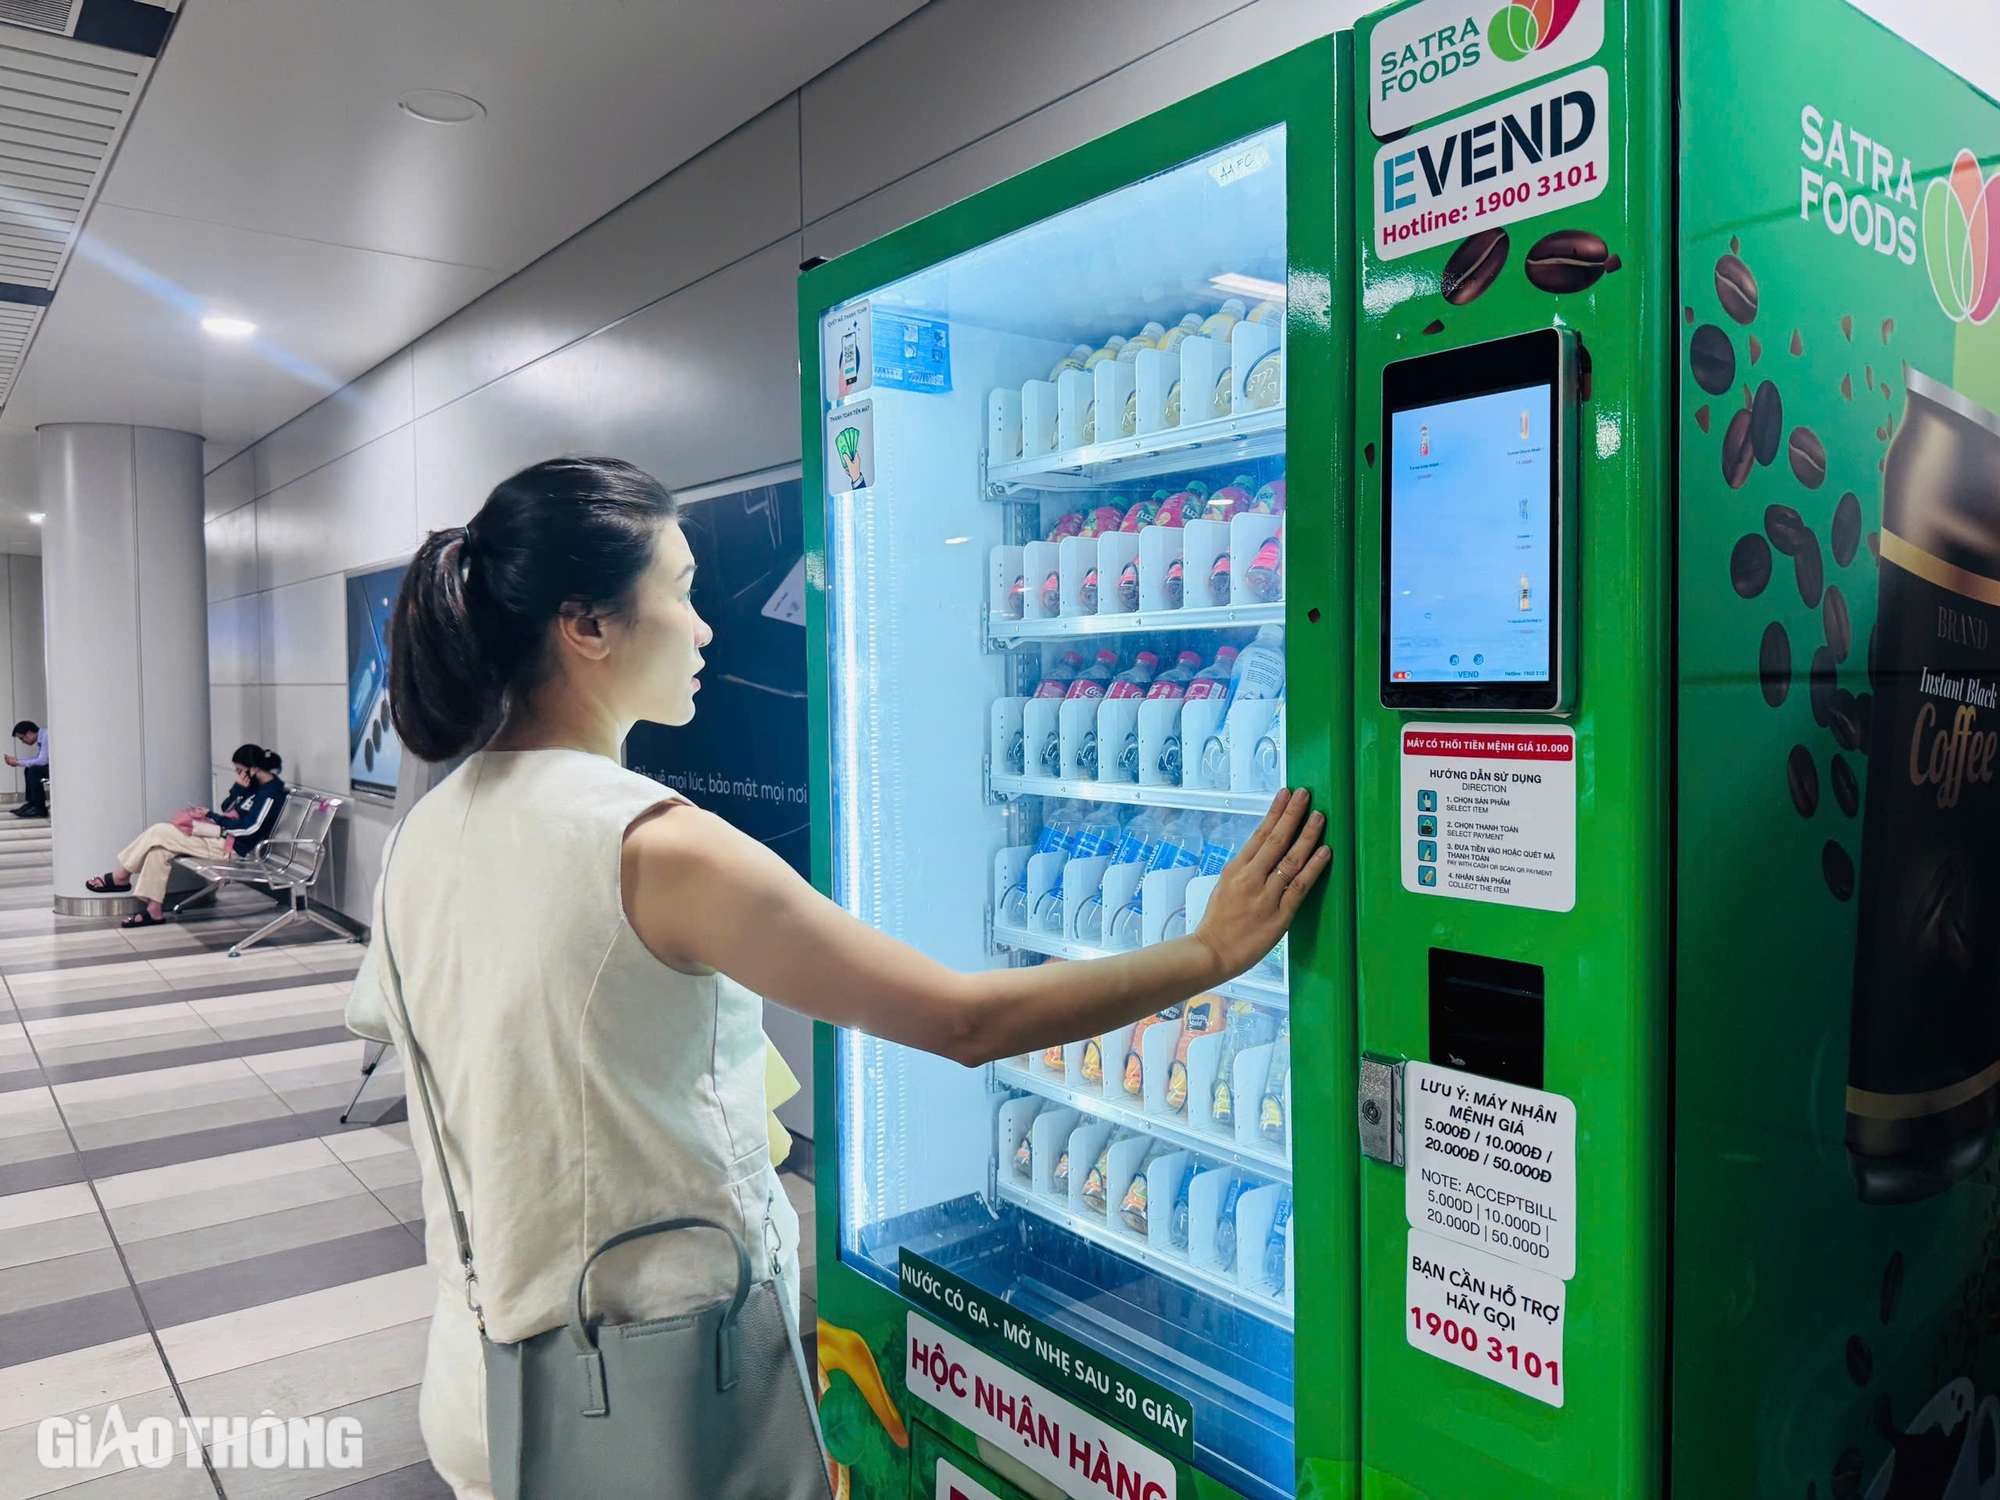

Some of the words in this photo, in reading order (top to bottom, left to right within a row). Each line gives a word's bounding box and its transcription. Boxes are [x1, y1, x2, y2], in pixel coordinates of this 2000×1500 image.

[1380, 17, 1480, 75] SATRA
[1381, 42, 1480, 101] FOODS
[1384, 90, 1595, 213] EVEND
[1801, 105, 1918, 211] SATRA
[1383, 205, 1468, 245] Hotline:
[1475, 182, 1531, 216] 1900
[1537, 161, 1597, 197] 3101
[1800, 166, 1917, 266] FOODS
[1937, 606, 1989, 649] BRAND
[1920, 666, 1963, 701] Instant
[1965, 678, 1998, 709] Black
[1406, 738, 1424, 748] MÁY
[1425, 738, 1438, 748] CÓ
[1439, 738, 1462, 749] THỐI
[1463, 738, 1485, 750] TIỀN
[1487, 740, 1514, 753] MỆNH
[1517, 741, 1534, 752] GIÁ
[1535, 743, 1569, 753] 10.000
[1910, 702, 1998, 809] Coffee
[668, 771, 687, 793] mọi
[689, 771, 707, 794] lúc,
[708, 773, 731, 794] bảo
[733, 777, 758, 801] mật
[761, 781, 784, 805] mọi
[788, 783, 807, 804] nơi
[1430, 768, 1467, 781] HƯỚNG
[1470, 768, 1491, 781] DẪN
[1494, 771, 1509, 782] SỬ
[1511, 773, 1542, 785] DỤNG
[1462, 783, 1507, 793] DIRECTION
[1453, 797, 1473, 805] CHỌN
[1474, 796, 1489, 805] SẢN
[1447, 830, 1471, 838] SELECT
[1473, 832, 1504, 841] PAYMENT
[1454, 822, 1474, 830] CHỌN
[1476, 823, 1498, 831] THANH
[1500, 825, 1519, 833] TOÁN
[1447, 852, 1470, 860] THANH
[1471, 853, 1490, 862] TOÁN
[1454, 844, 1469, 852] ĐƯA
[1471, 843, 1486, 852] TIỀN
[1486, 846, 1501, 854] VÀO
[1502, 848, 1522, 857] HOẶC
[1523, 850, 1542, 859] QUÉT
[1526, 868, 1553, 876] PAYMENT
[1448, 881, 1478, 890] COLLECT
[1479, 884, 1492, 892] THE
[1493, 886, 1510, 894] ITEM
[1455, 873, 1474, 882] NHẬN
[1475, 874, 1489, 883] SẢN
[1420, 1078, 1451, 1097] LƯU
[1457, 1085, 1470, 1102] Ý:
[1473, 1092, 1507, 1111] MÁY
[1511, 1101, 1557, 1124] NHẬN
[1449, 1105, 1494, 1127] MỆNH
[1498, 1118, 1525, 1136] GIÁ
[1424, 1117, 1470, 1140] 5.000Đ
[1485, 1134, 1542, 1160] 10.000Đ
[1425, 1137, 1480, 1162] 20.000Đ
[1492, 1155, 1552, 1183] 50.000Đ
[1421, 1168, 1461, 1192] NOTE:
[1466, 1182, 1557, 1222] ACCEPTBILL
[1427, 1189, 1473, 1214] 5.000D
[1485, 1208, 1541, 1236] 10.000D
[1427, 1208, 1480, 1235] 20.000D
[1491, 1231, 1550, 1259] 50.000D
[1412, 1255, 1445, 1280] BẠN
[1449, 1268, 1485, 1296] CẦN
[1490, 1284, 1516, 1307] HỖ
[1521, 1295, 1560, 1325] TRỢ
[1446, 1291, 1480, 1315] HÃY
[1484, 1306, 1515, 1331] GỌI
[901, 1262, 941, 1300] NƯỚC
[944, 1288, 964, 1311] CÓ
[968, 1301, 989, 1328] GA
[1003, 1319, 1031, 1349] MỞ
[1035, 1338, 1070, 1376] NHẸ
[1075, 1360, 1110, 1395] SAU
[1115, 1380, 1137, 1410] 30
[1142, 1398, 1188, 1438] GIÂY
[1411, 1306, 1478, 1352] 1900
[1487, 1336, 1558, 1386] 3101
[911, 1337, 967, 1398] HỘC
[975, 1375, 1060, 1458] NHẬN
